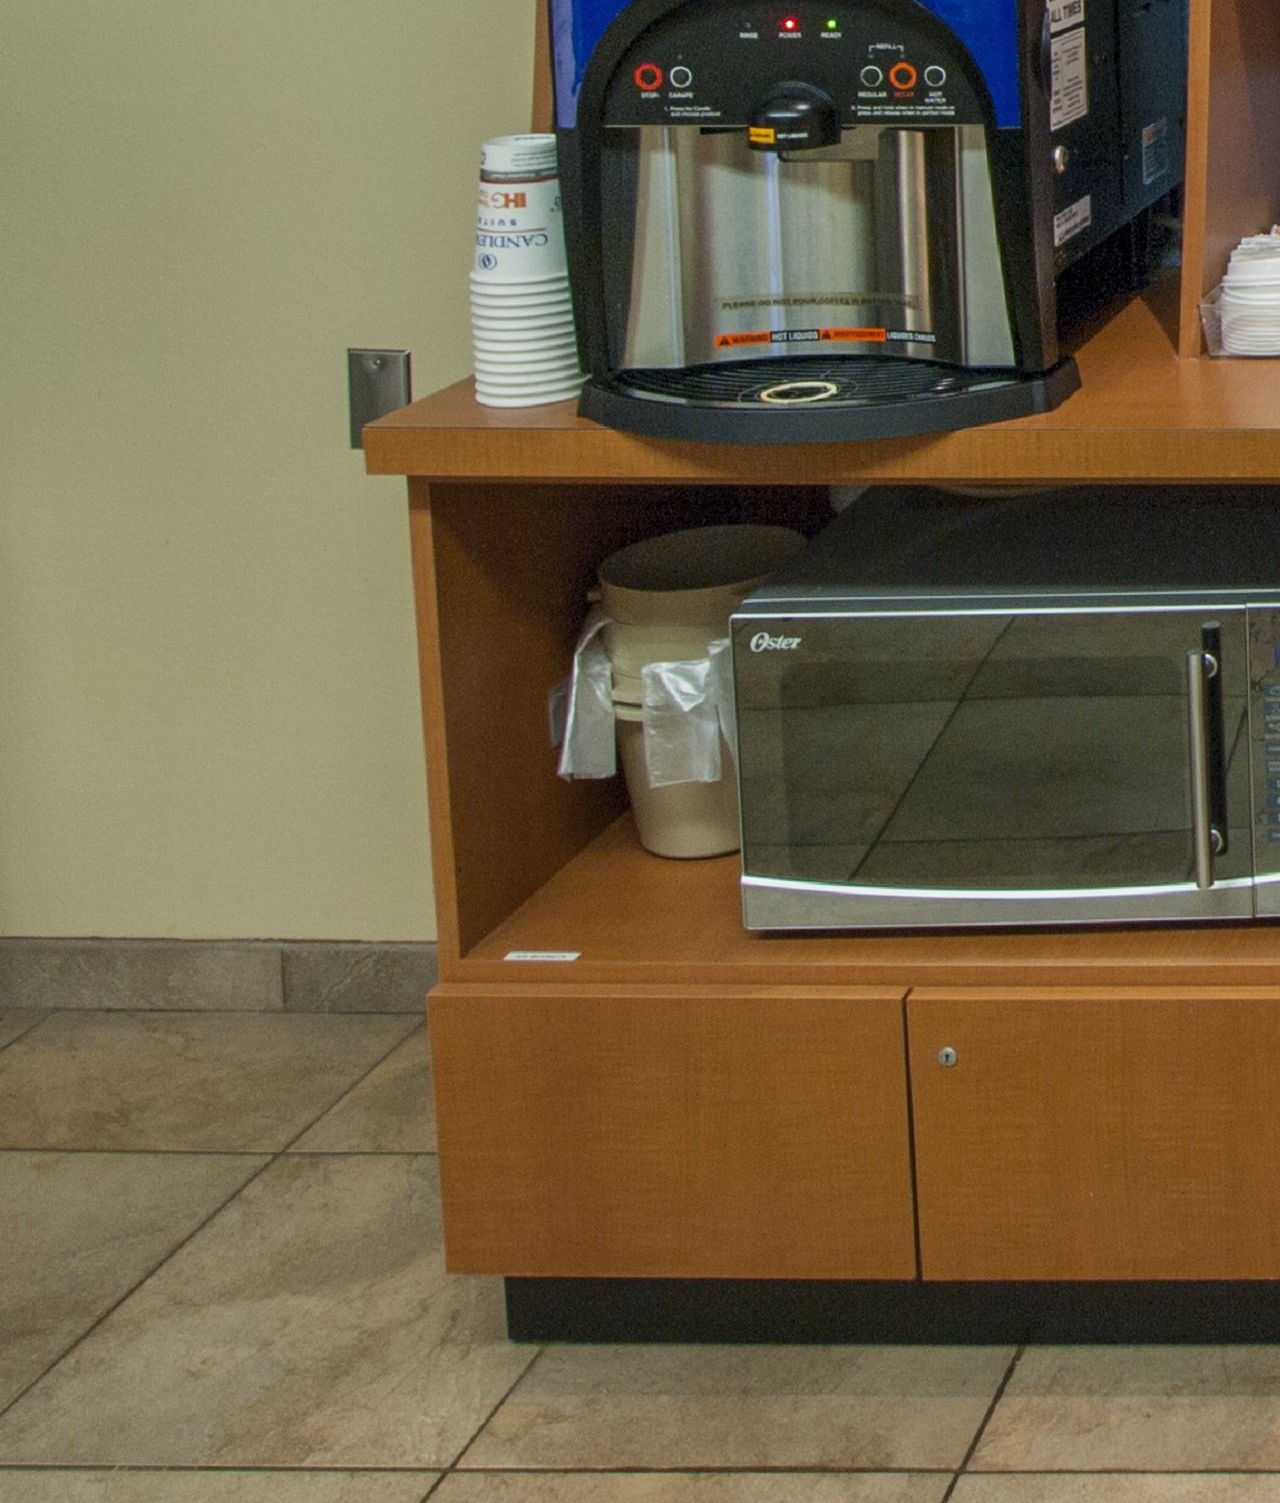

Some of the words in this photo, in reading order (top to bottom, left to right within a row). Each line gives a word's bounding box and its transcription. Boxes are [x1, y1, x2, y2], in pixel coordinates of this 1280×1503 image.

[1051, 7, 1062, 23] ALL
[1062, 0, 1082, 18] TIMES
[750, 631, 802, 653] Oster
